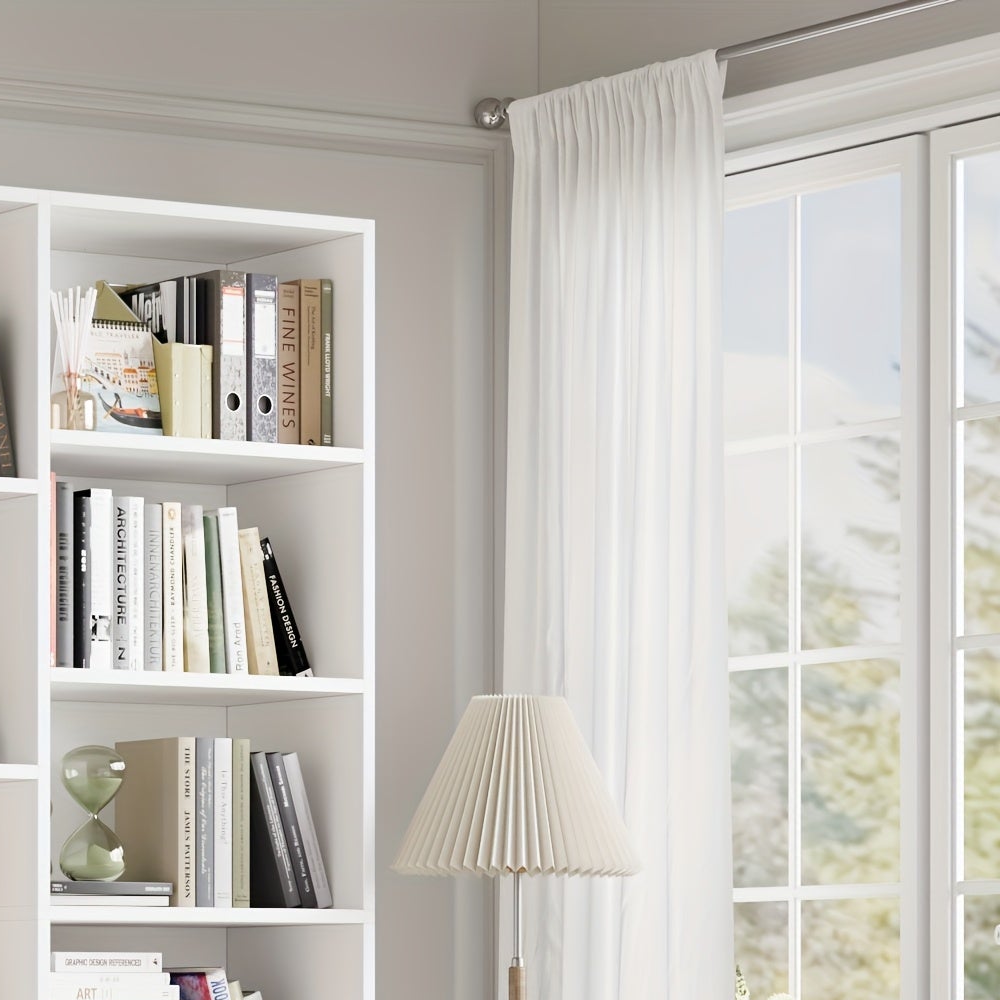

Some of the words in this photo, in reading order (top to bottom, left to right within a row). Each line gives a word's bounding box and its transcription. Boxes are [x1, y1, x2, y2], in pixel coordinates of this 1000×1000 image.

[280, 306, 295, 353] FINE
[280, 362, 295, 428] WINES
[115, 506, 127, 625] ARCHITECTURE
[268, 574, 286, 614] FASHION
[280, 614, 298, 649] DESIGN
[232, 620, 242, 646] Arad
[234, 648, 245, 671] Ron
[183, 747, 191, 764] THE
[183, 768, 191, 798] STORE
[183, 810, 191, 841] JAMES
[183, 844, 191, 899] PATTERSON
[64, 958, 88, 967] GRAPHIC
[88, 958, 108, 967] DESIGN
[108, 958, 142, 967] REFERENCED
[76, 987, 98, 1000] ART
